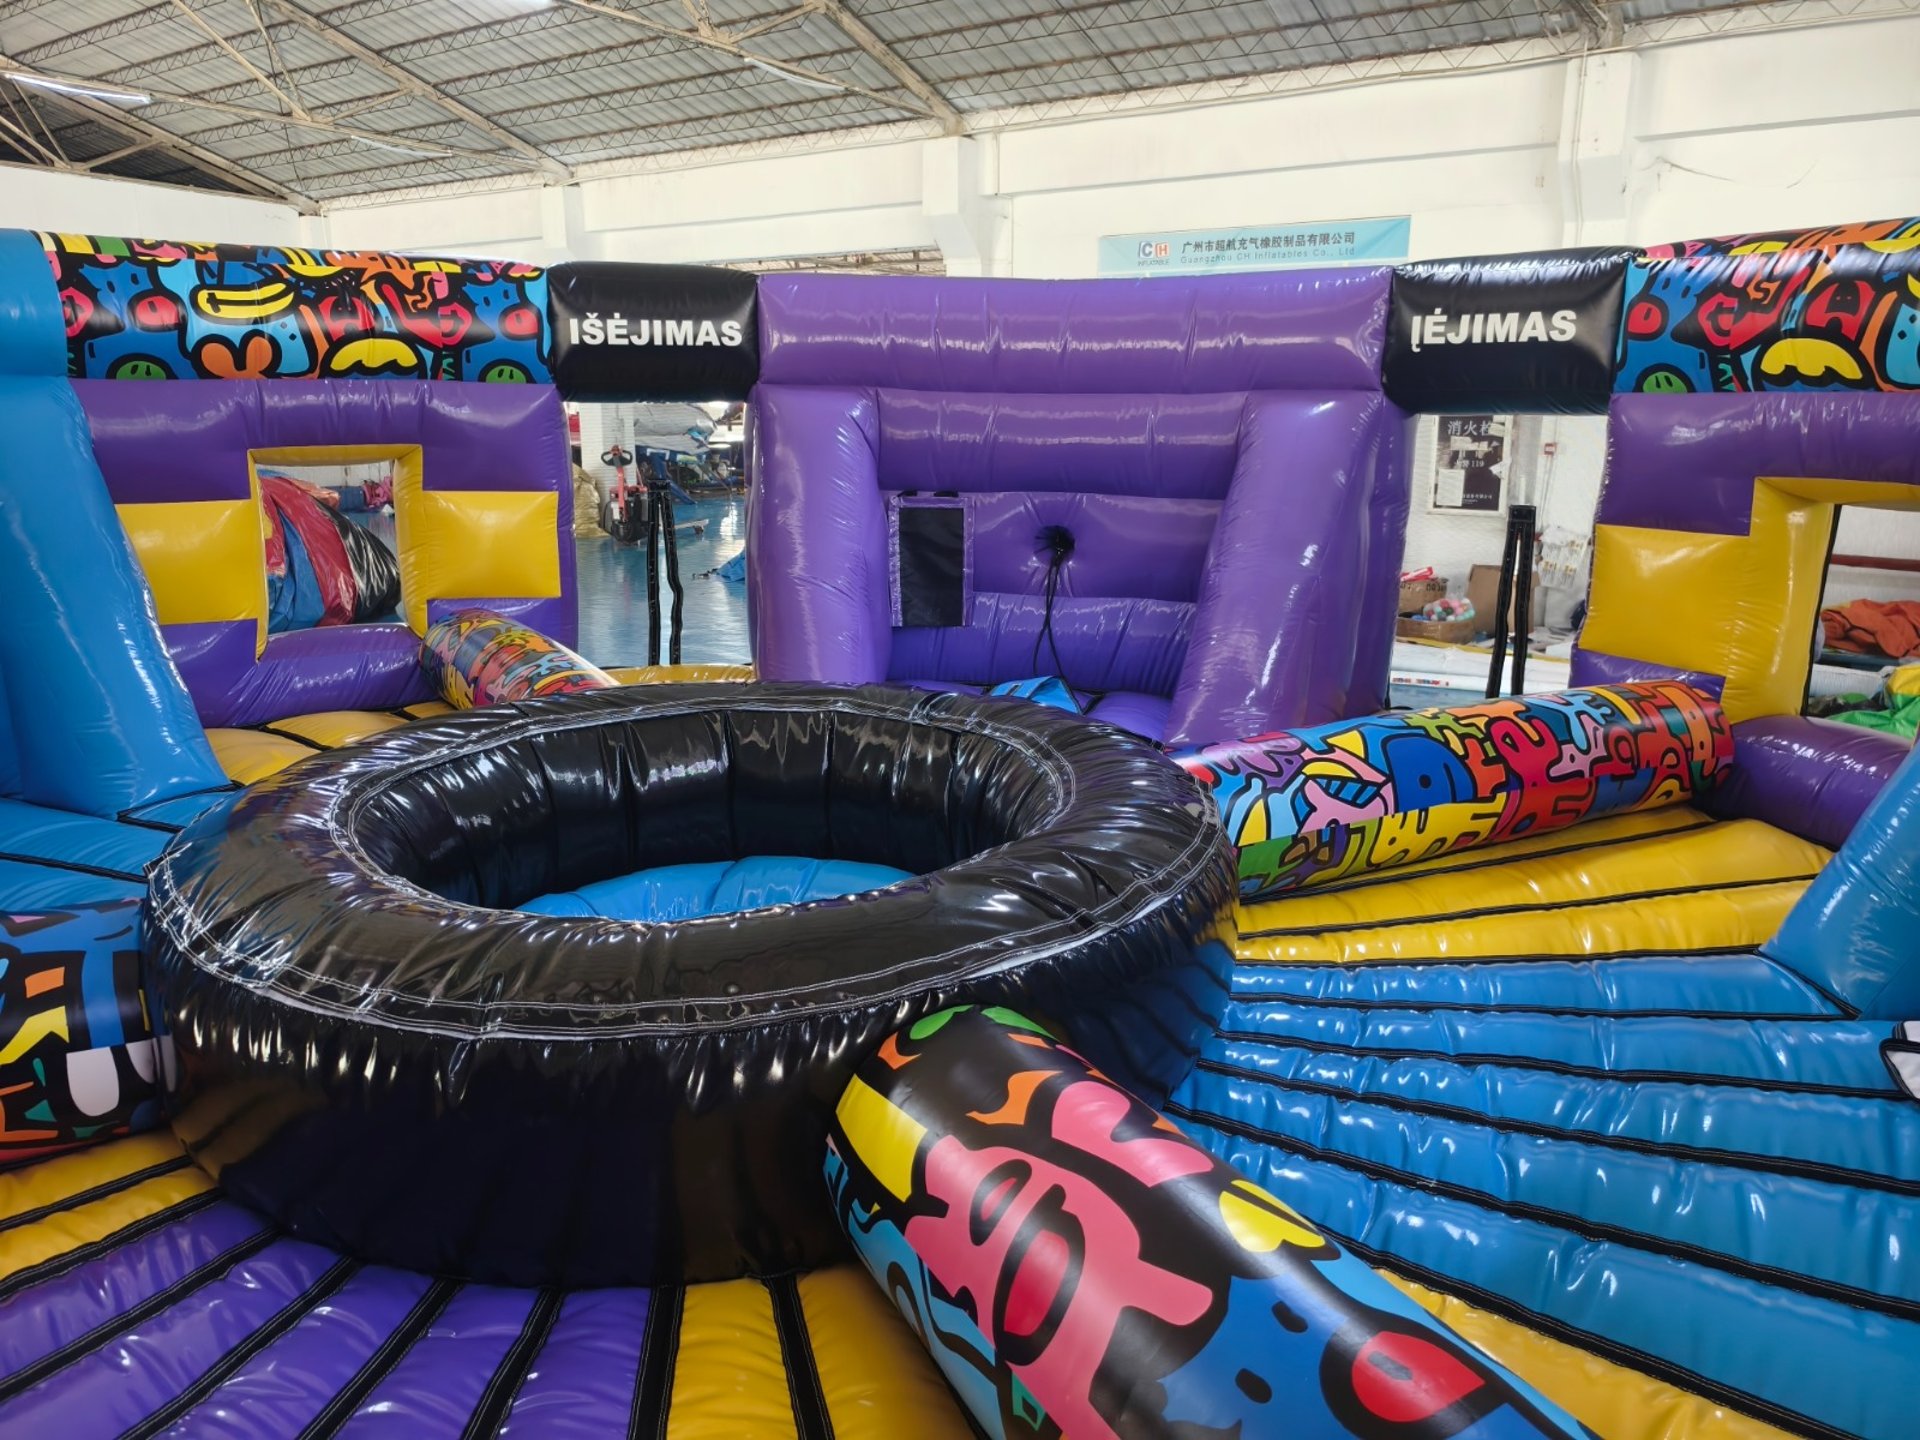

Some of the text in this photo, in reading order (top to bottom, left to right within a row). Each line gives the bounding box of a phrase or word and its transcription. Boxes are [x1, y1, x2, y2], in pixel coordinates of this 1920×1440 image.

[1180, 254, 1232, 264] Guangzhou
[1237, 252, 1250, 260] CH
[1254, 250, 1308, 260] Inflatables
[1181, 231, 1355, 254] 广州市超航充气橡胶制品有限公司
[569, 312, 743, 347] IŠĖJIMAS
[1410, 307, 1578, 353] ĮĖJIMAS
